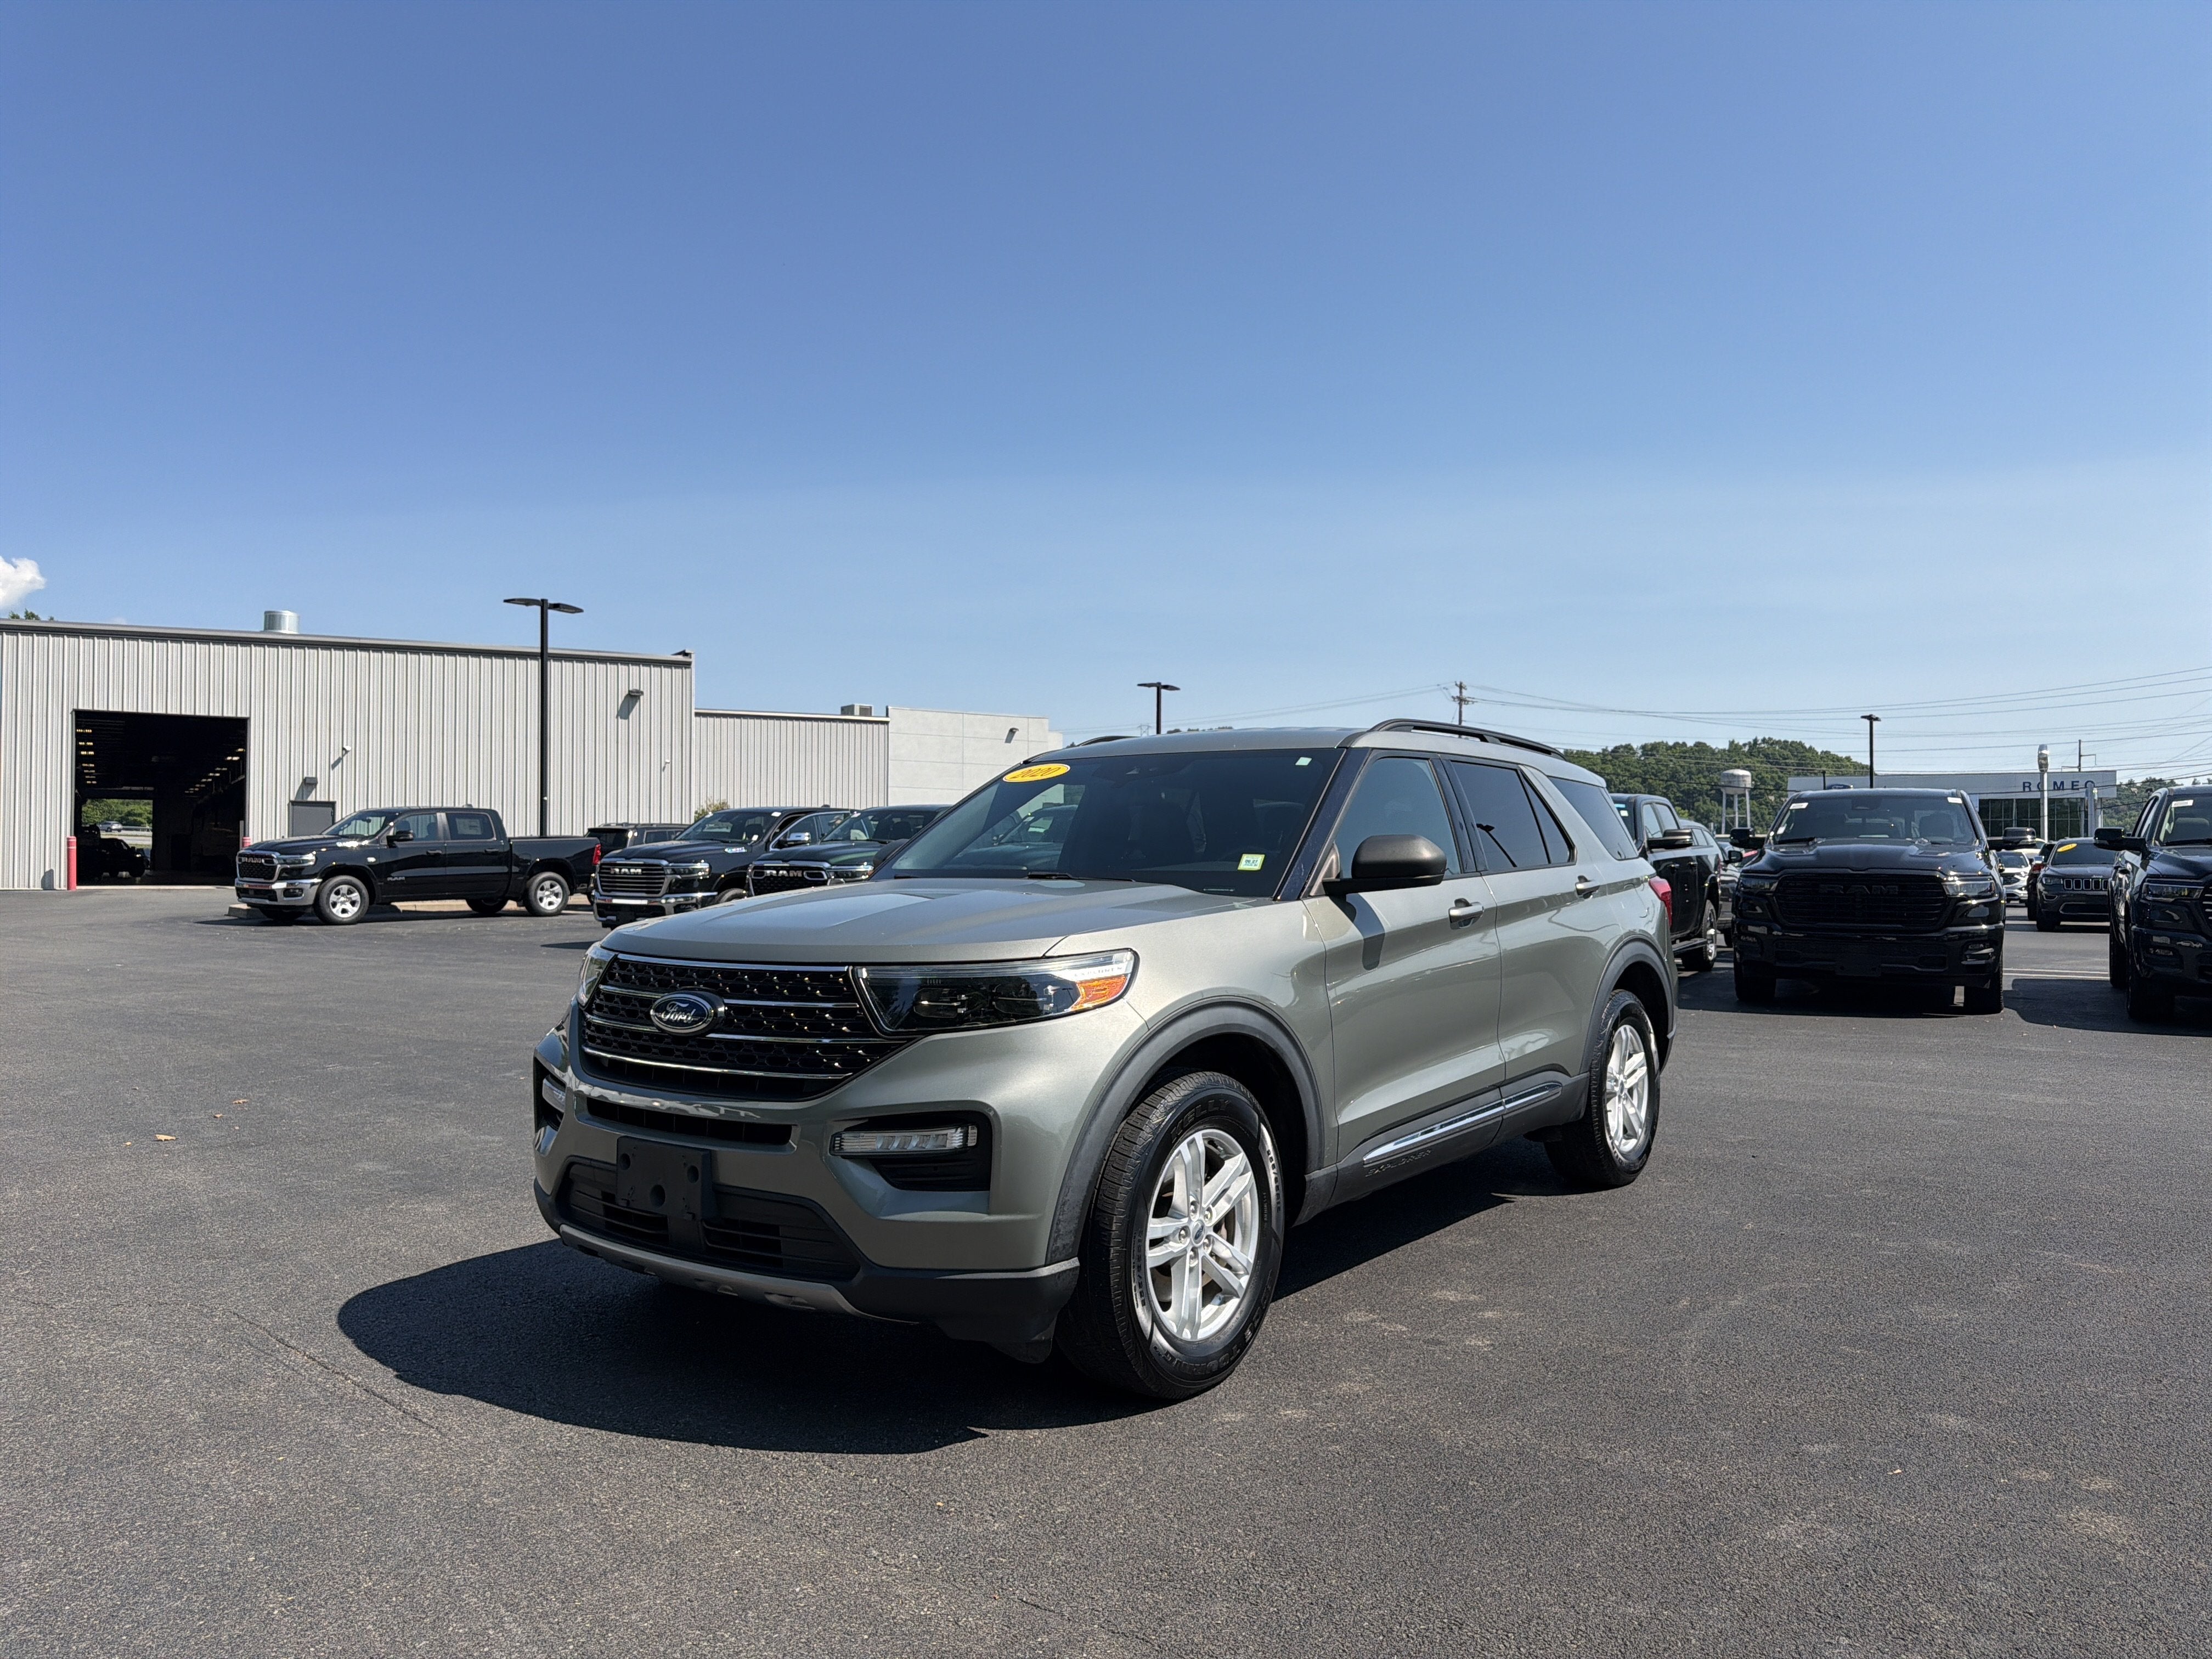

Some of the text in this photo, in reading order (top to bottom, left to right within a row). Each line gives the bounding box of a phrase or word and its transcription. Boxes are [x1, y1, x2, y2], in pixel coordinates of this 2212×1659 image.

[1009, 767, 1062, 779] 2020
[1819, 884, 1899, 895] RAM
[658, 1001, 699, 1024] Ford
[1170, 1098, 1229, 1144] KELLY
